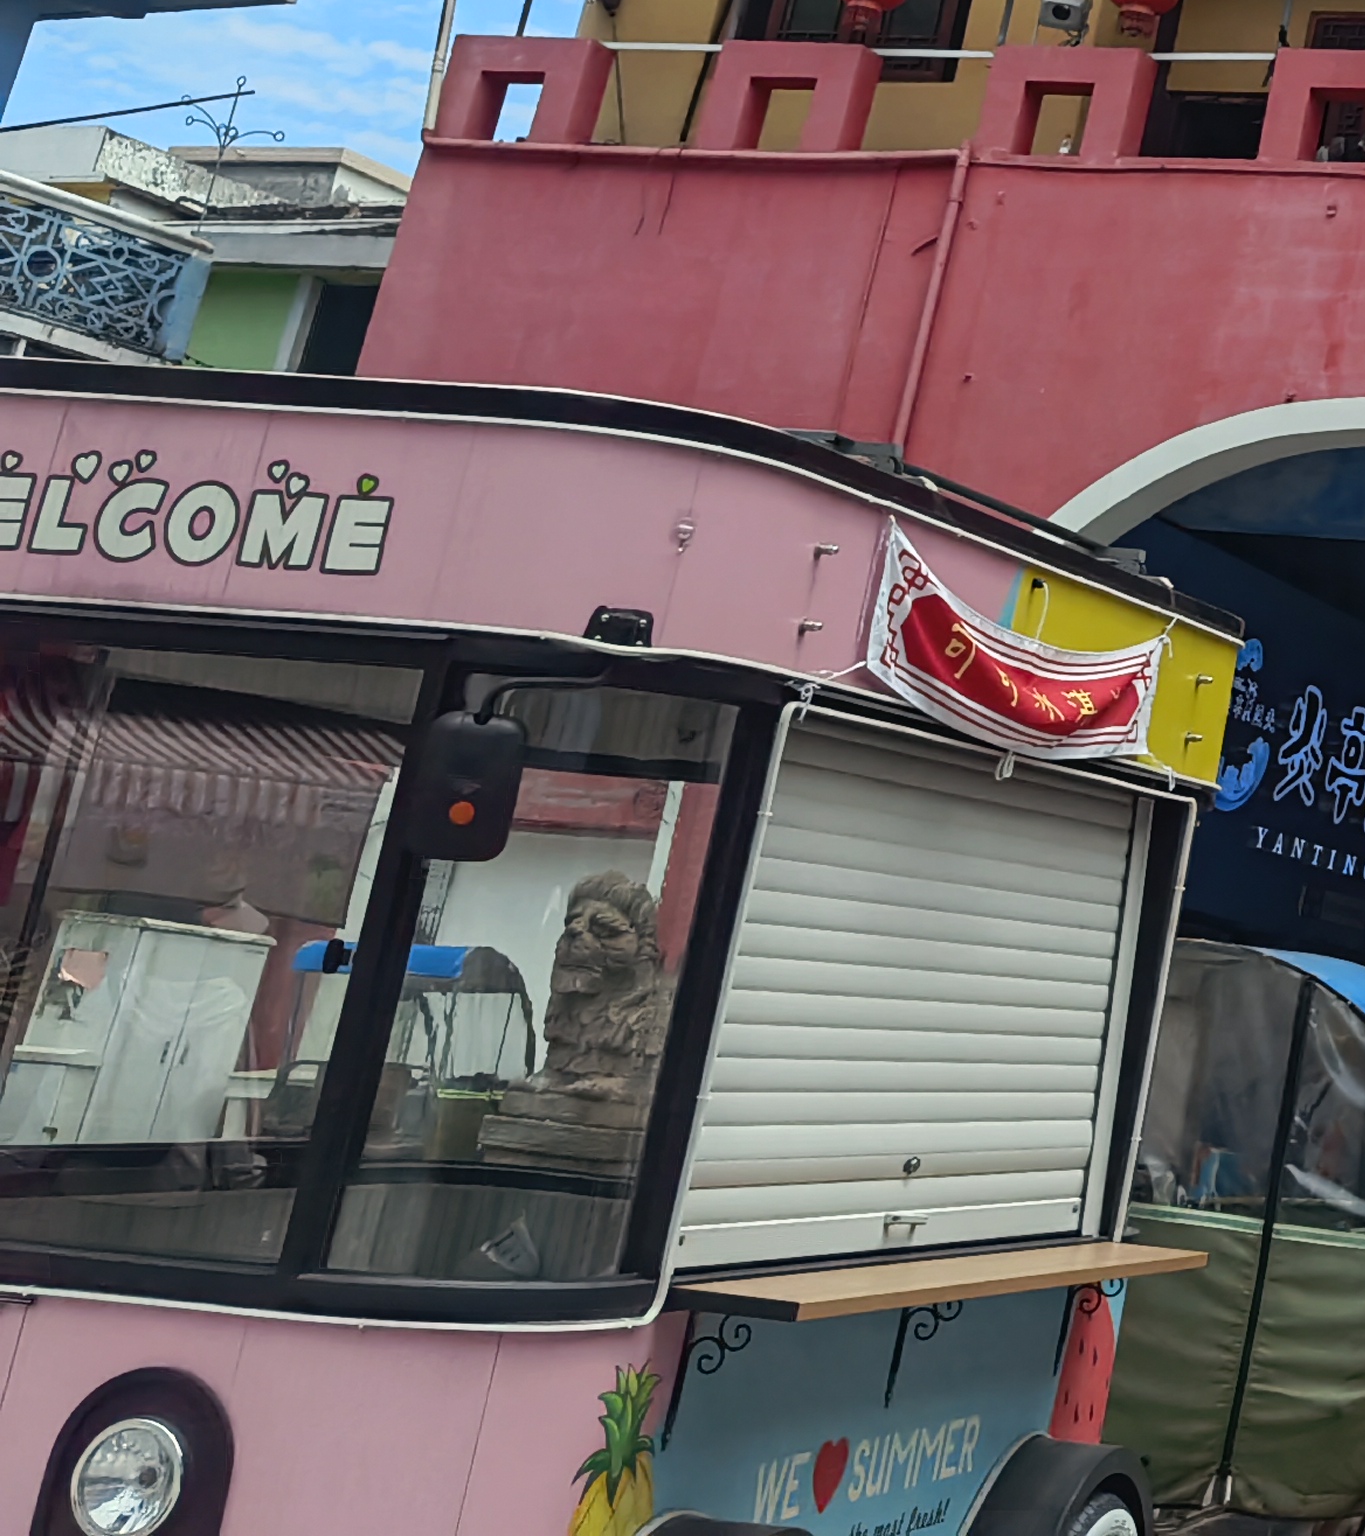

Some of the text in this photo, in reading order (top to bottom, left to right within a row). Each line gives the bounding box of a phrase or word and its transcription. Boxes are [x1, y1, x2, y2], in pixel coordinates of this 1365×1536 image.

[753, 1415, 980, 1524] WE SUMMER
[873, 1511, 904, 1536] most
